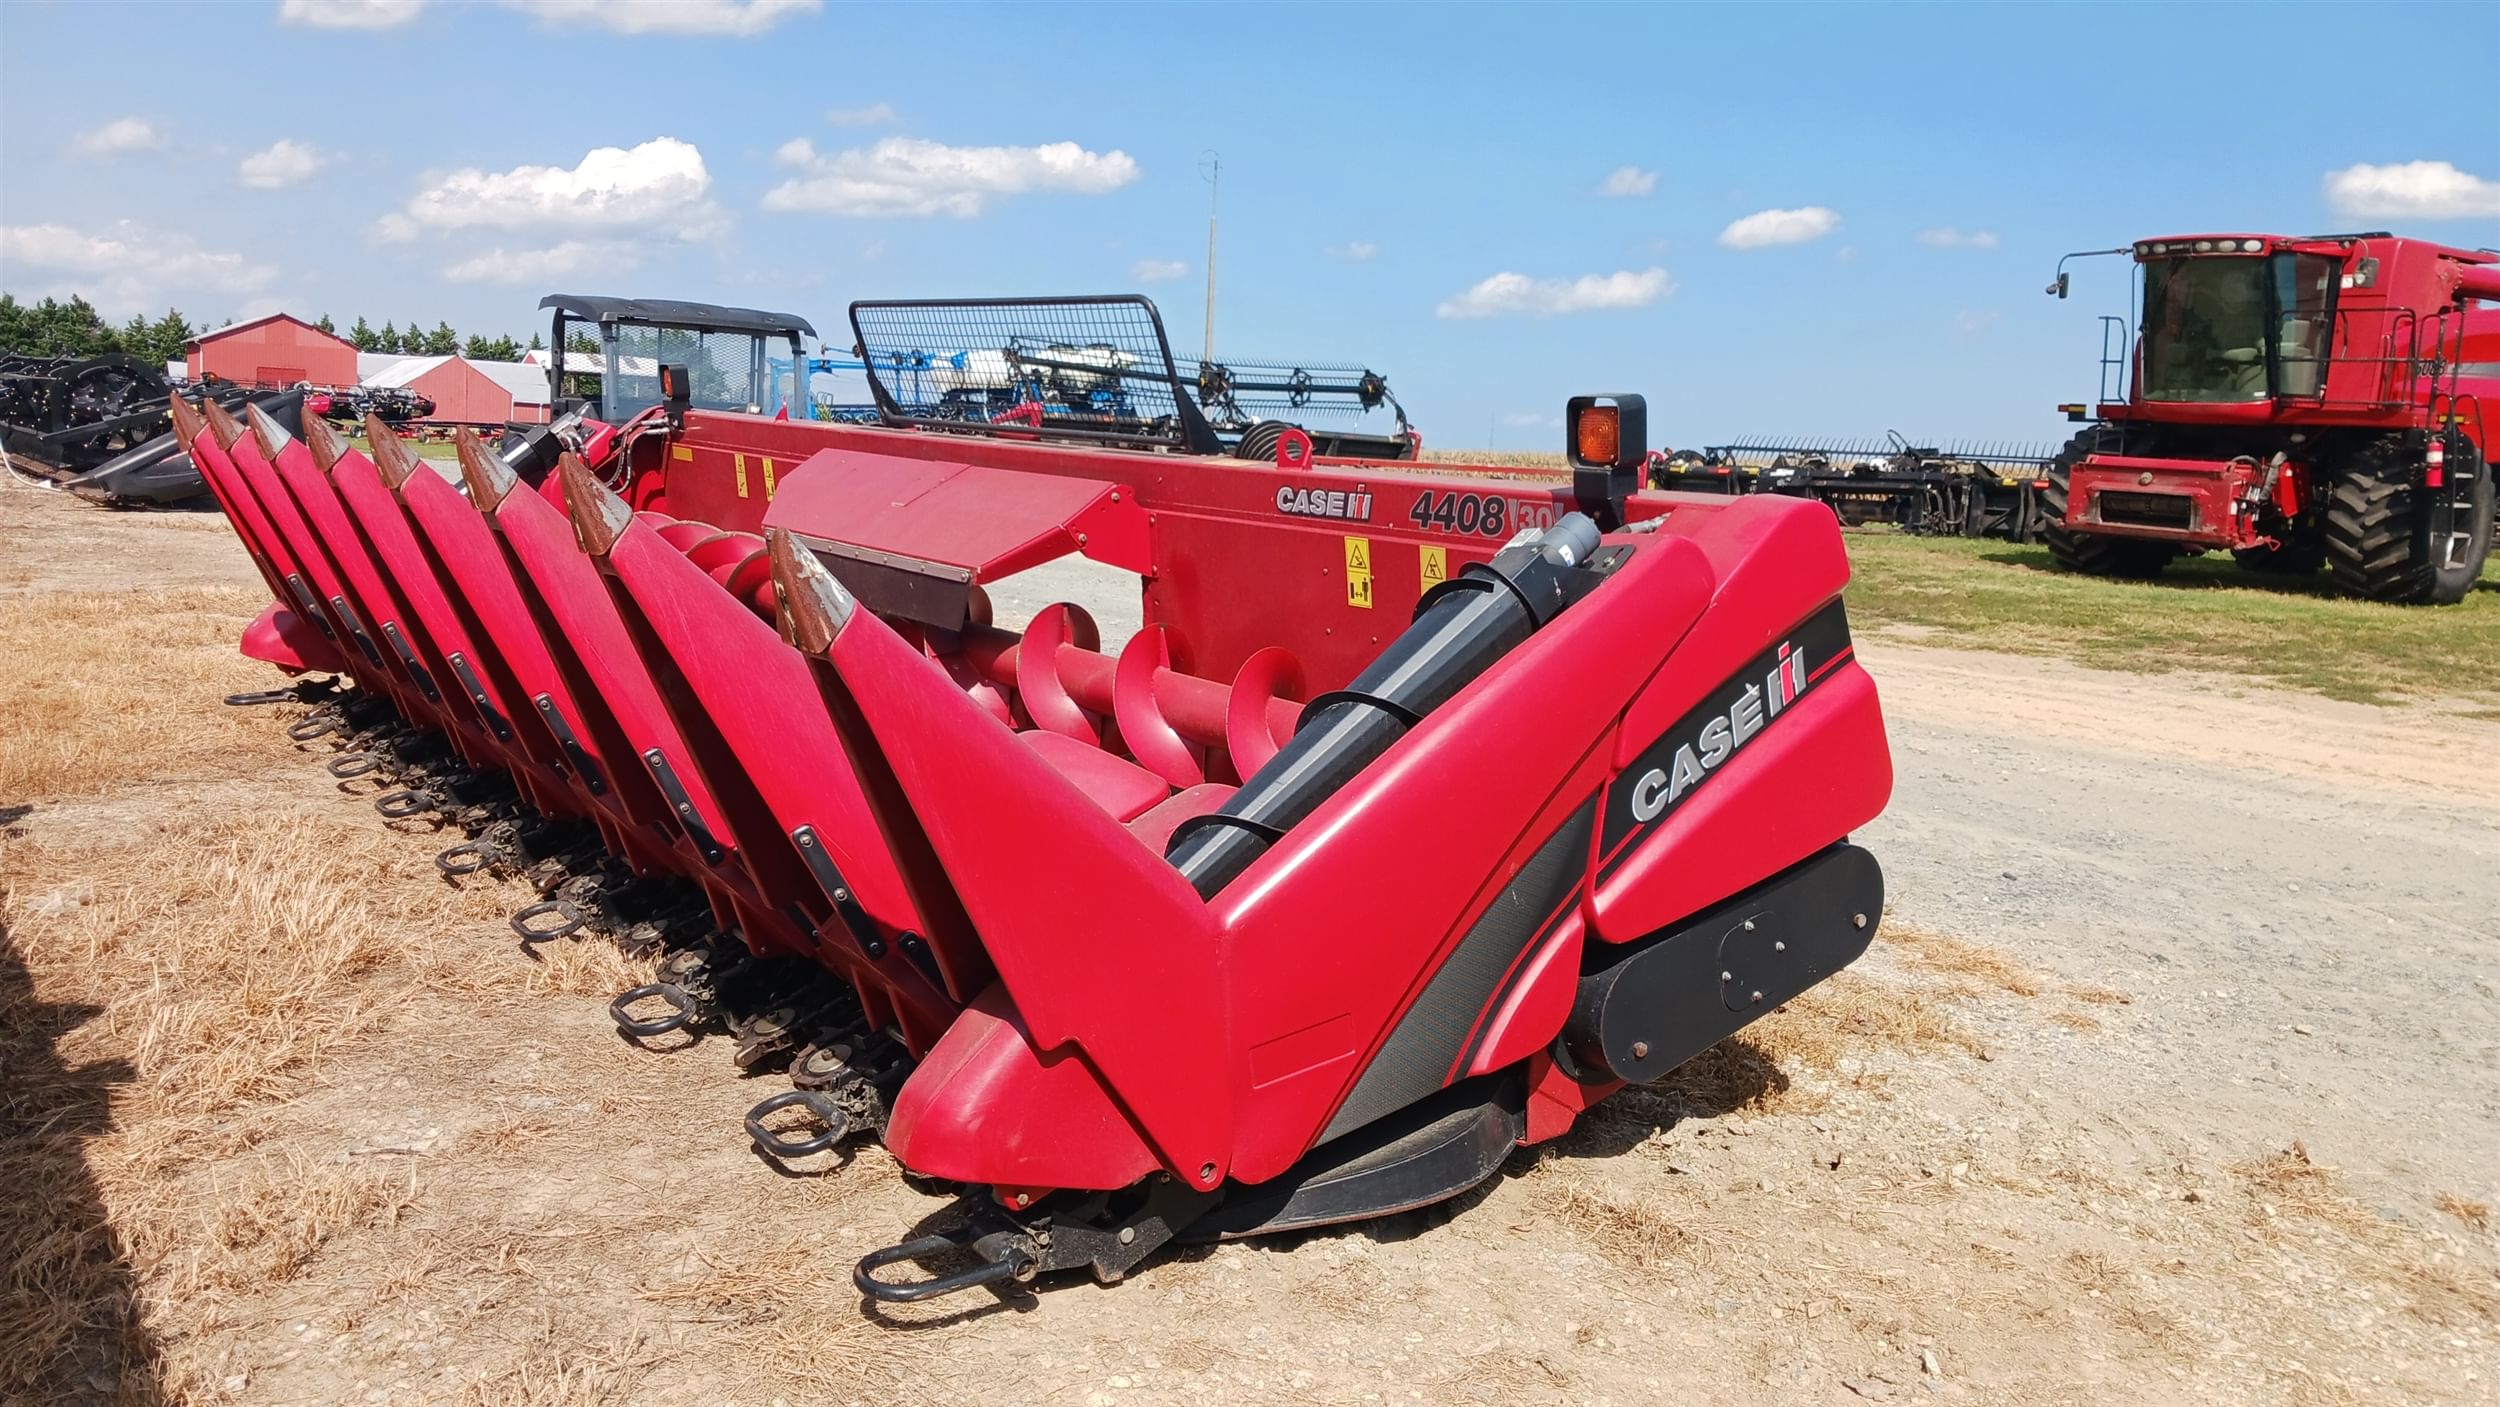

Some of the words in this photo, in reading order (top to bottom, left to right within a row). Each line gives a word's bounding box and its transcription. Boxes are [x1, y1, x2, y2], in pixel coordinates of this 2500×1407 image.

[1276, 486, 1345, 517] CASE
[1409, 490, 1505, 538] 4408
[1519, 506, 1551, 534] 30
[1632, 684, 1764, 822] CASE
